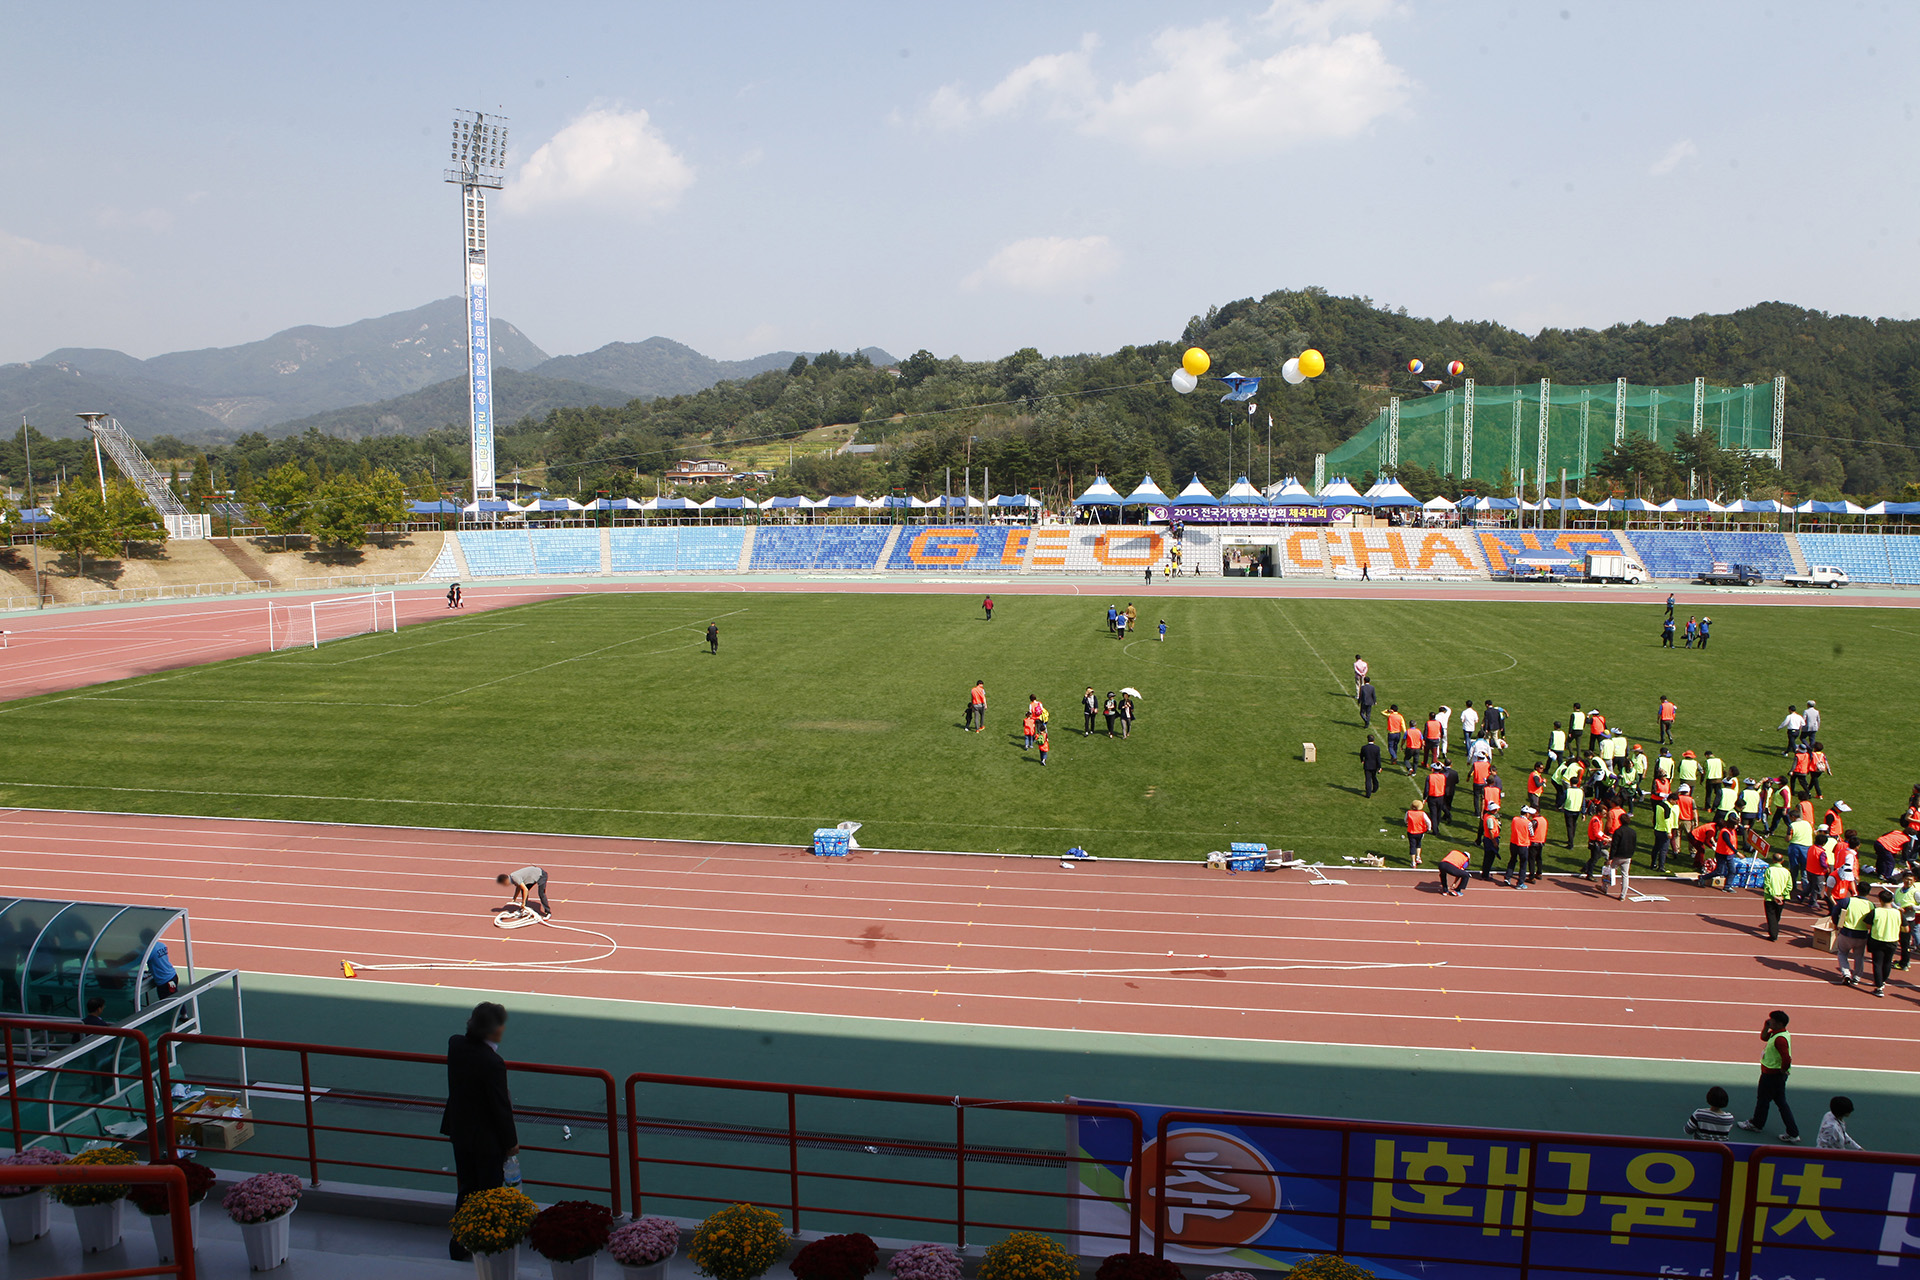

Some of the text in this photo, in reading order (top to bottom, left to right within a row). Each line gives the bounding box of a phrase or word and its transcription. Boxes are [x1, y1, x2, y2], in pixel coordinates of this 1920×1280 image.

[475, 326, 486, 350] 도시
[475, 352, 487, 376] 창조
[476, 380, 487, 405] 거창
[1174, 508, 1199, 518] 2015
[1289, 507, 1327, 519] 체육대회
[908, 529, 1164, 566] GEO
